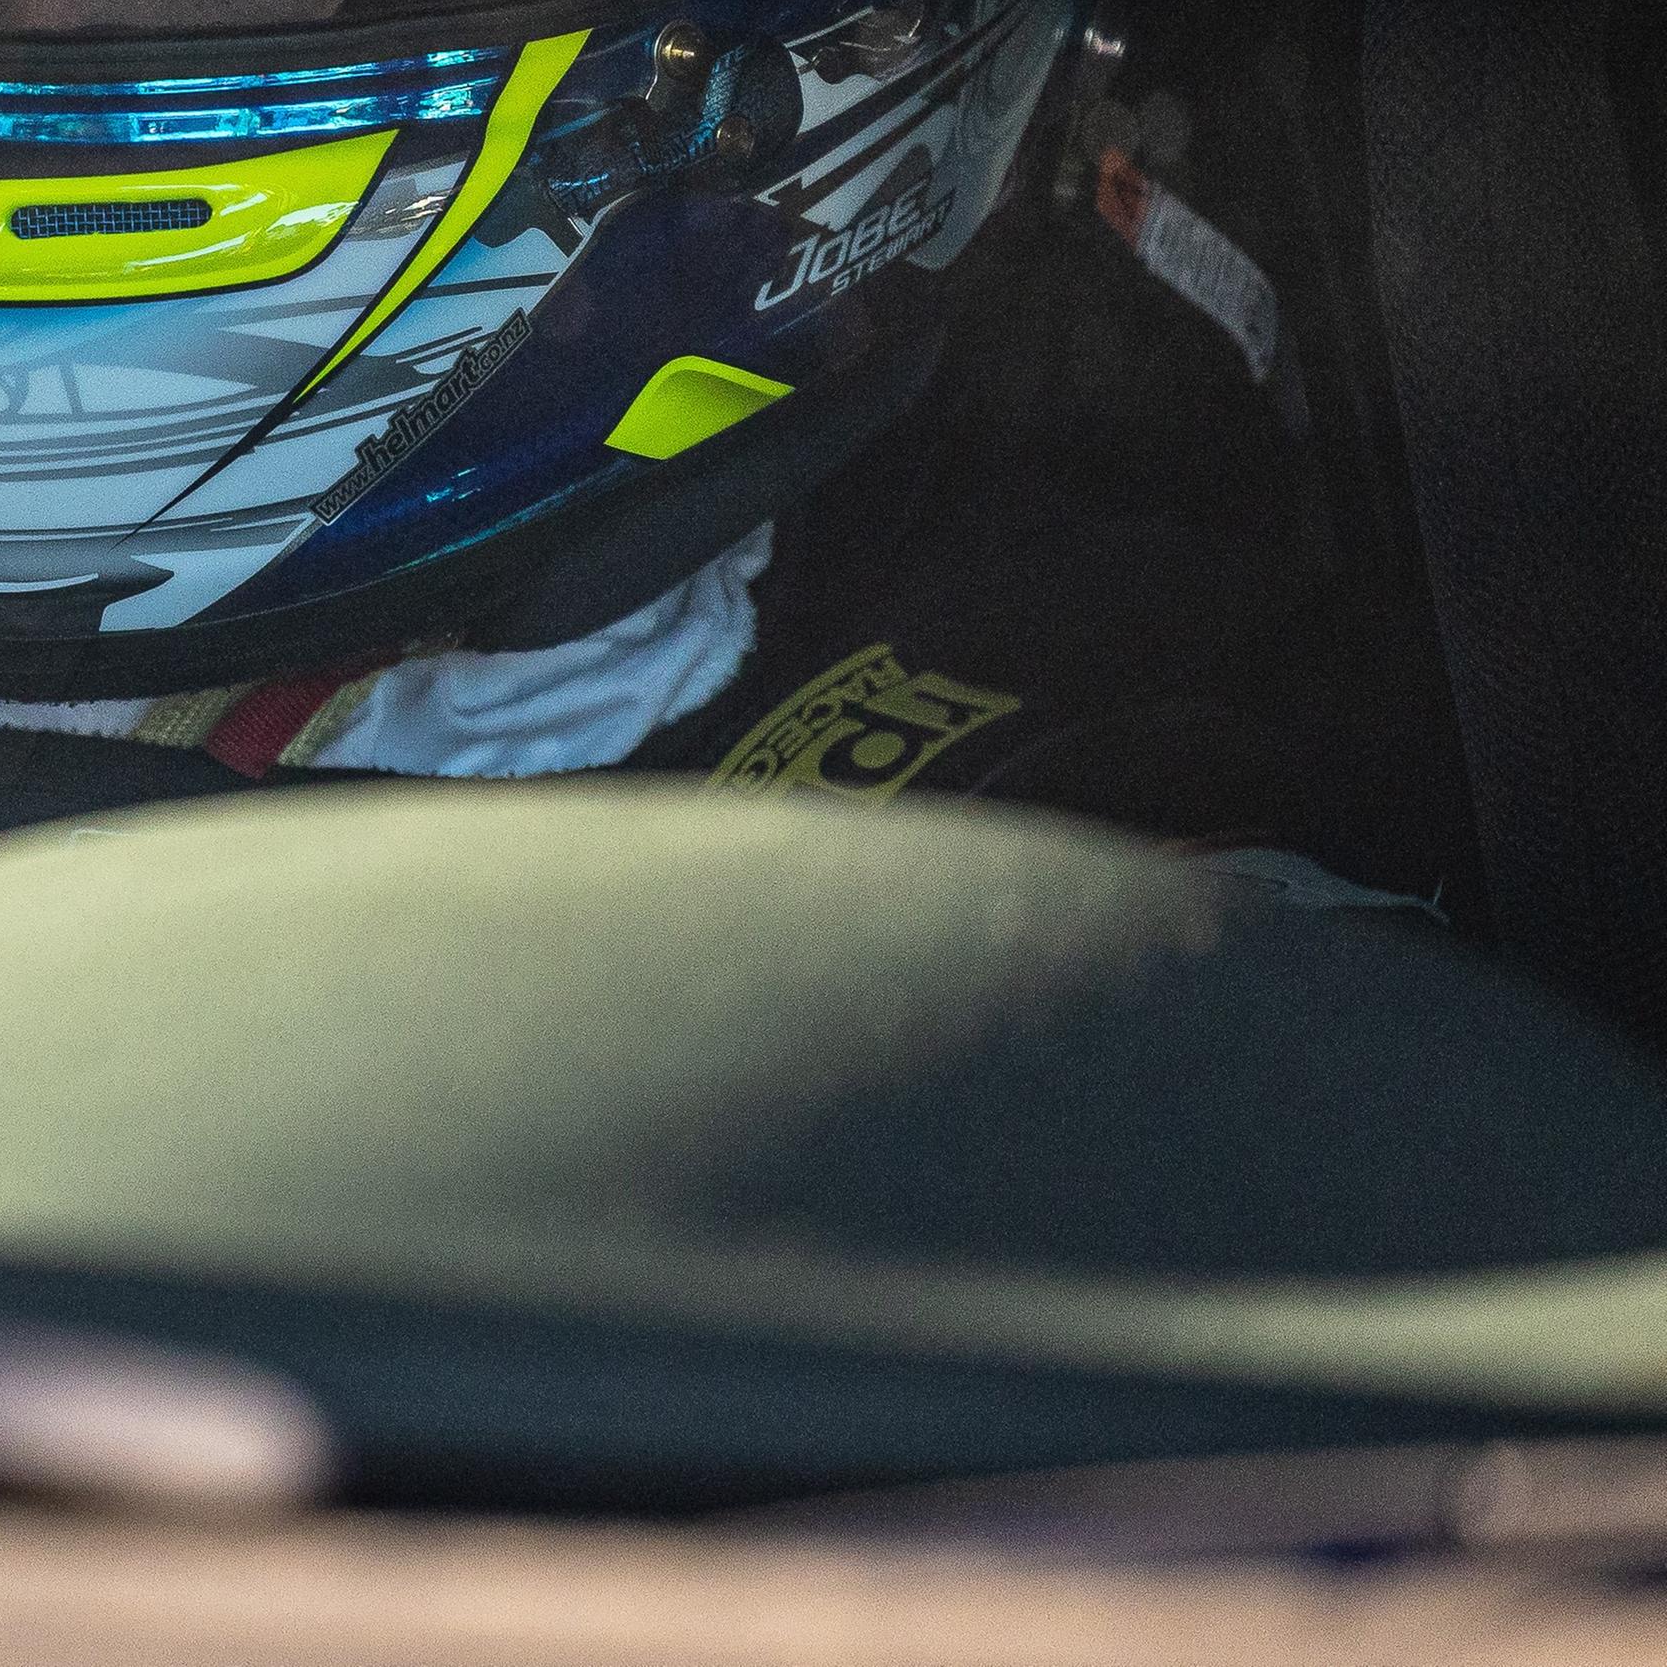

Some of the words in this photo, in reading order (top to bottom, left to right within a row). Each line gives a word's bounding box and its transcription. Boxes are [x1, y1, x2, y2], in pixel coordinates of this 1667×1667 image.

[753, 178, 933, 312] JOBE
[830, 190, 953, 297] STEWART
[316, 316, 527, 521] www.helmart.co.nz
